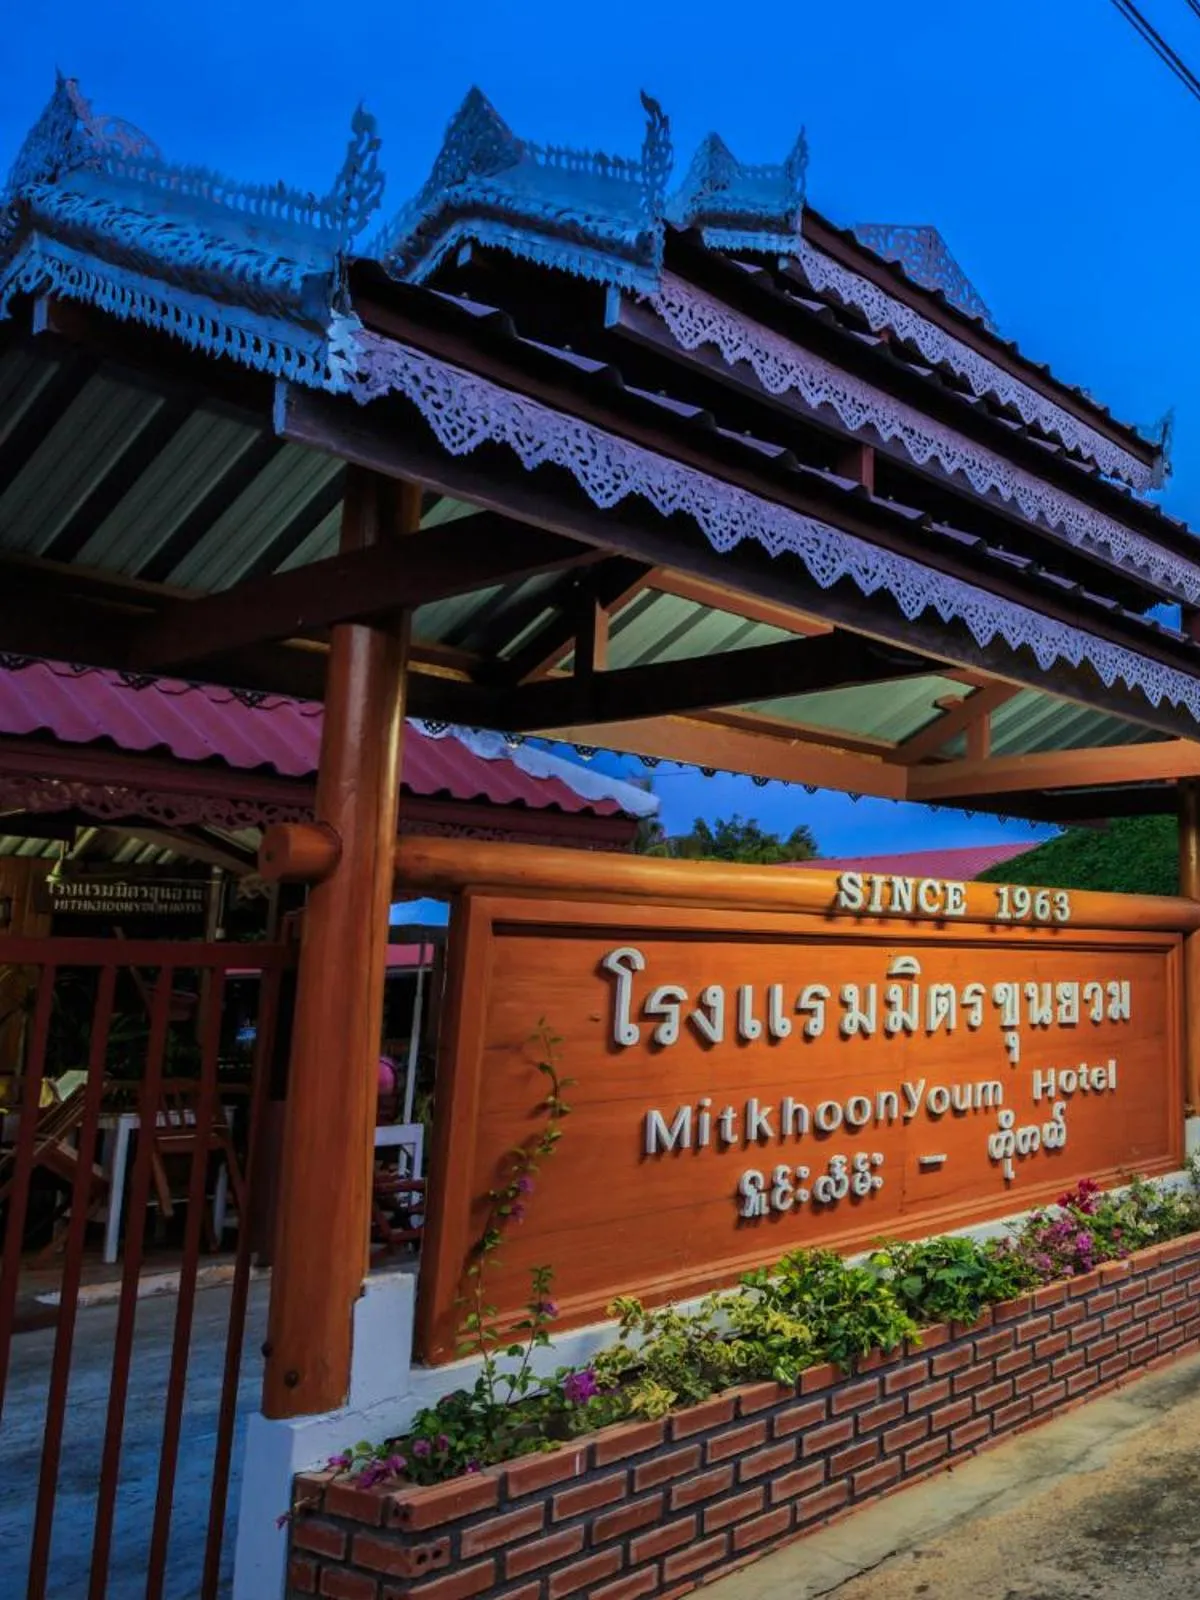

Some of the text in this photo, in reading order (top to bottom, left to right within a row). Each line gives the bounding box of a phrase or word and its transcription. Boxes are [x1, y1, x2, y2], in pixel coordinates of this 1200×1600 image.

[838, 871, 1071, 923] SINCE 1963
[602, 946, 1132, 1064] โรงแรมมิตรขุนยวม
[1031, 1059, 1117, 1101] Hotel
